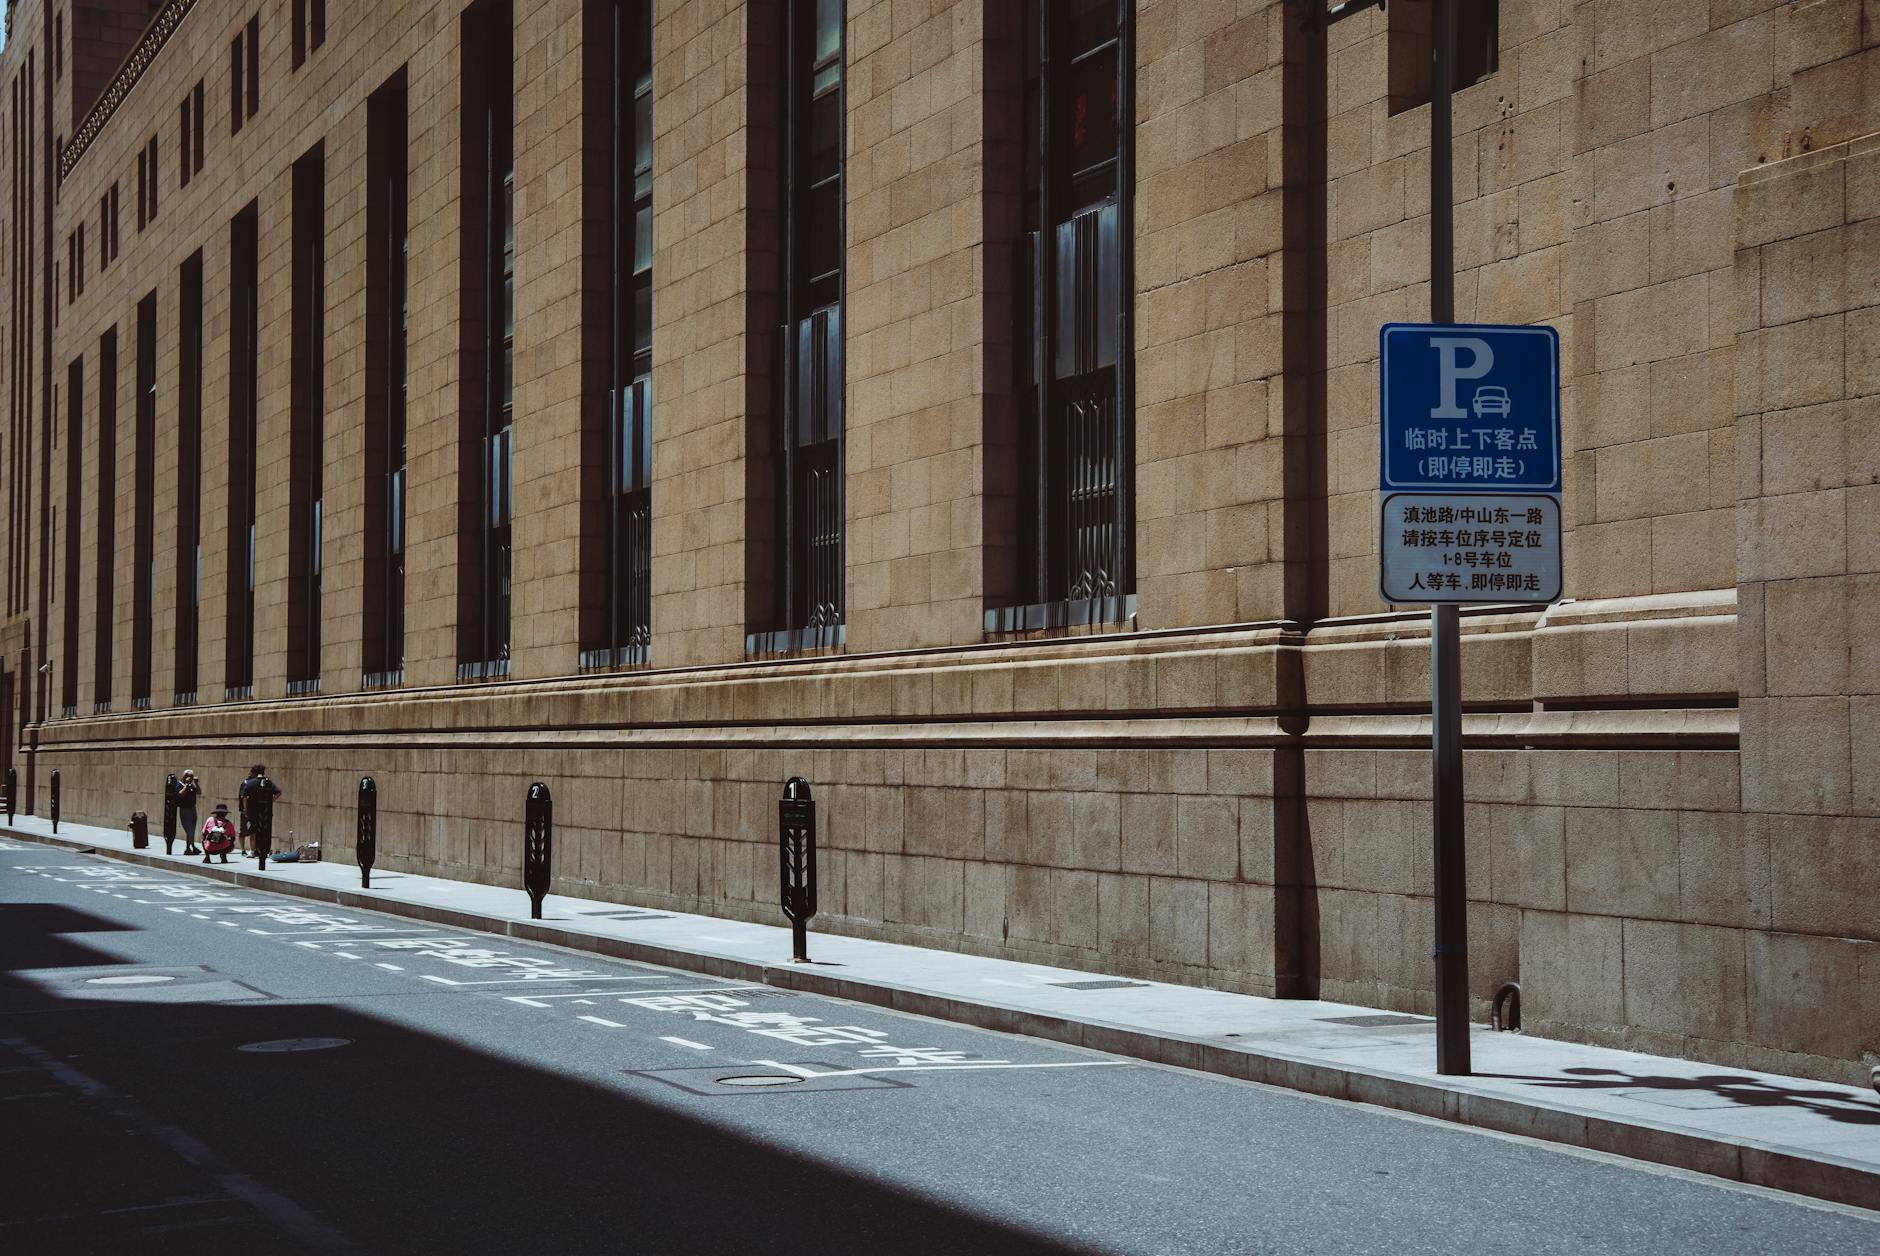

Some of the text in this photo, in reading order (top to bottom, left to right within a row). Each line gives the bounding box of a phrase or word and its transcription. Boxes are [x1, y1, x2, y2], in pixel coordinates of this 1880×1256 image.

[1430, 337, 1494, 418] P
[1405, 428, 1538, 451] 临时上下客点
[1403, 507, 1543, 525] 滇池路/中山东一路
[1402, 529, 1543, 548] 请按车位序号定位
[1443, 552, 1512, 568] 1-8号车位
[531, 785, 539, 799] 2
[789, 782, 795, 799] 1
[373, 939, 613, 980] 即停即走
[618, 995, 1010, 1066] 即停即走
